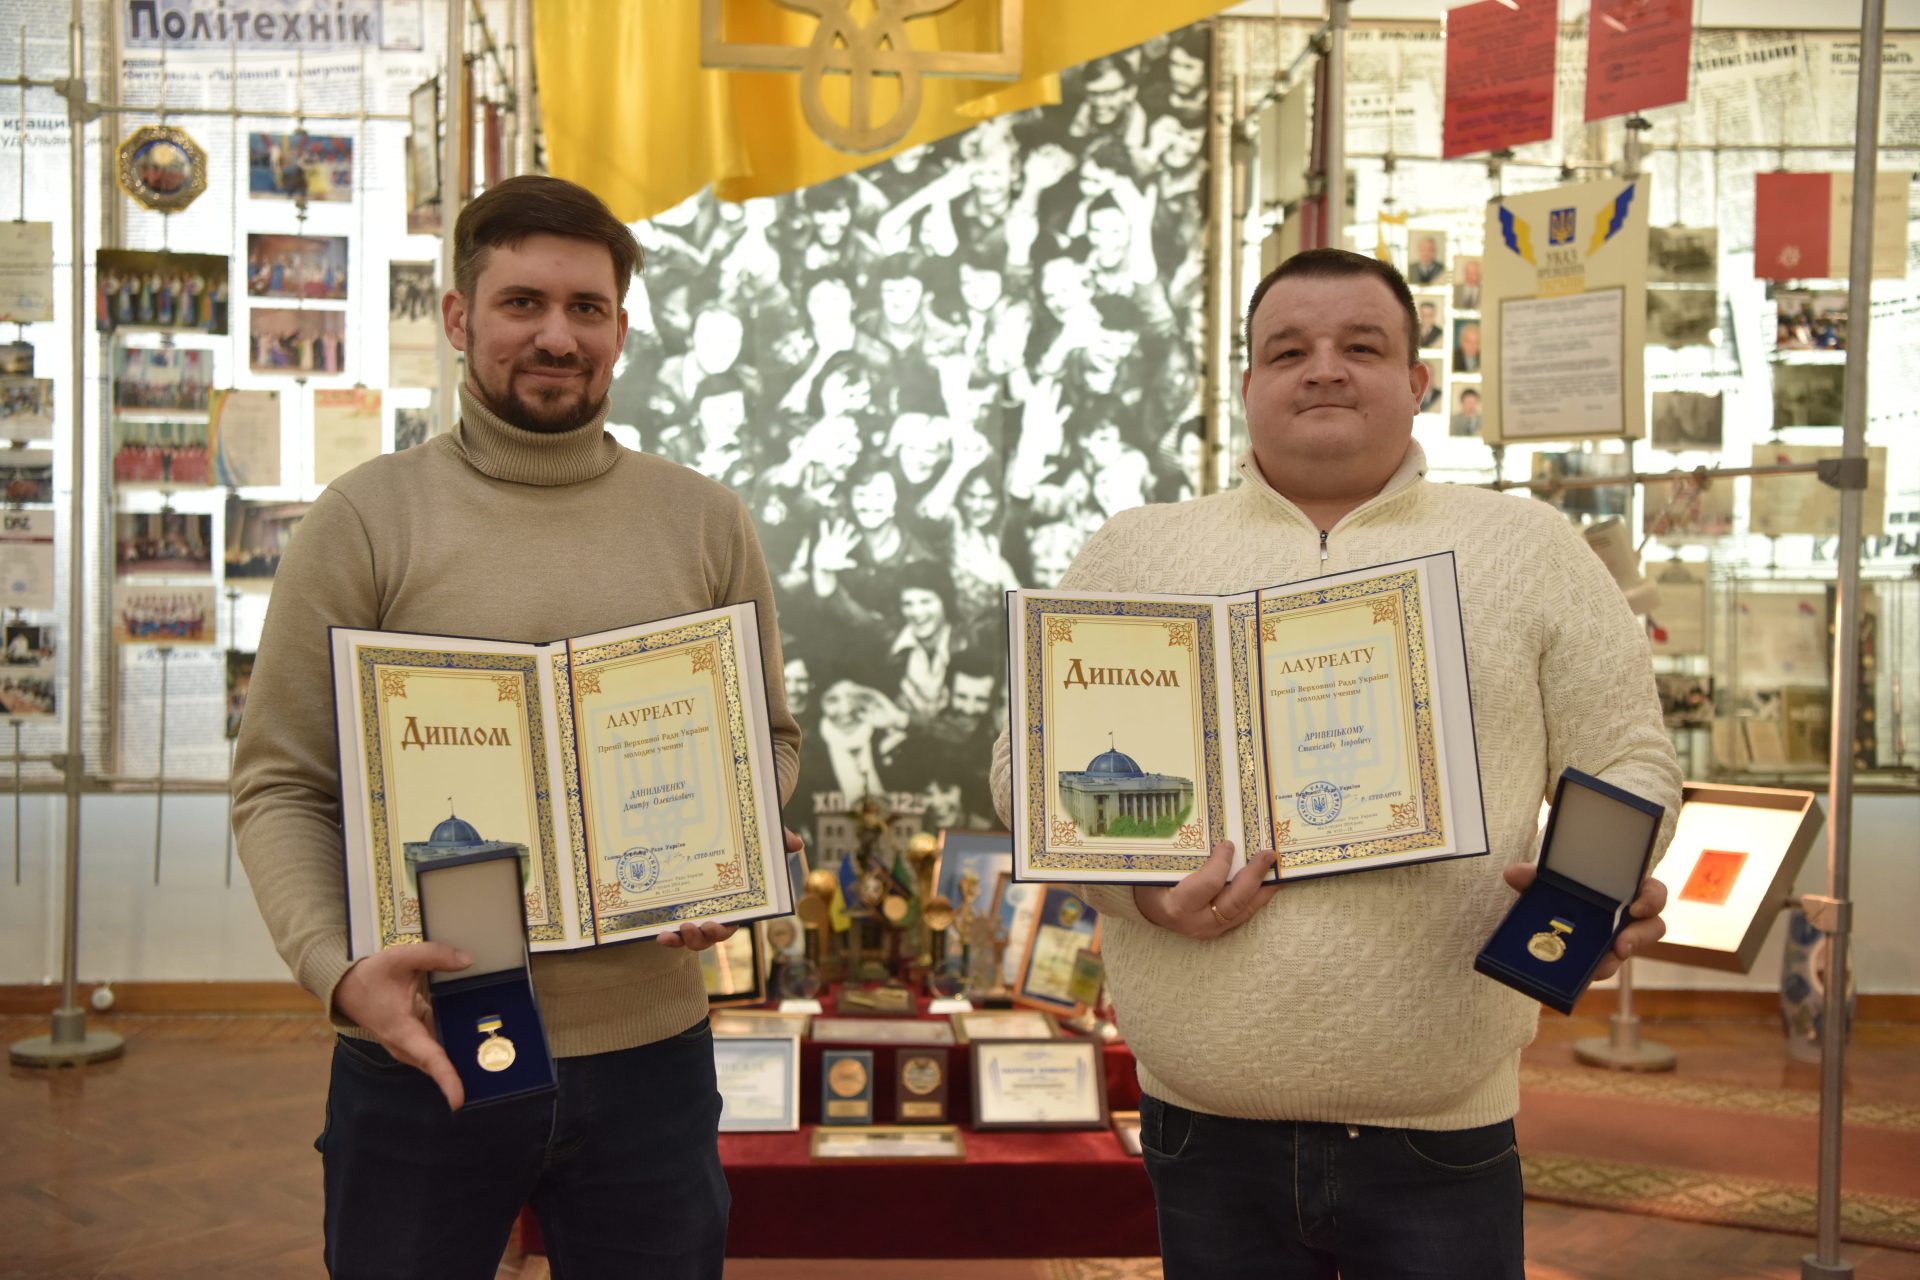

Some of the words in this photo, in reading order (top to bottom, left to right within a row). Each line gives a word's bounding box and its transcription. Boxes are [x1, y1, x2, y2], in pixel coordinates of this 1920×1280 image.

[129, 0, 373, 42] Політехнік
[1064, 658, 1181, 690] Диплом
[1280, 646, 1376, 674] ЛАУРЕАТУ
[1270, 685, 1297, 696] Премії
[1297, 680, 1337, 694] Верховної
[1337, 677, 1357, 687] Ради
[1358, 672, 1389, 684] України
[1296, 693, 1331, 703] молодим
[1332, 687, 1361, 699] ученим
[606, 697, 696, 729] ЛАУРЕАТУ
[401, 716, 512, 751] Диплом
[597, 743, 622, 754] Премії
[623, 734, 661, 749] Верховної
[661, 731, 680, 741] Ради
[680, 725, 710, 738] України
[623, 748, 657, 760] молодим
[657, 741, 685, 754] ученим
